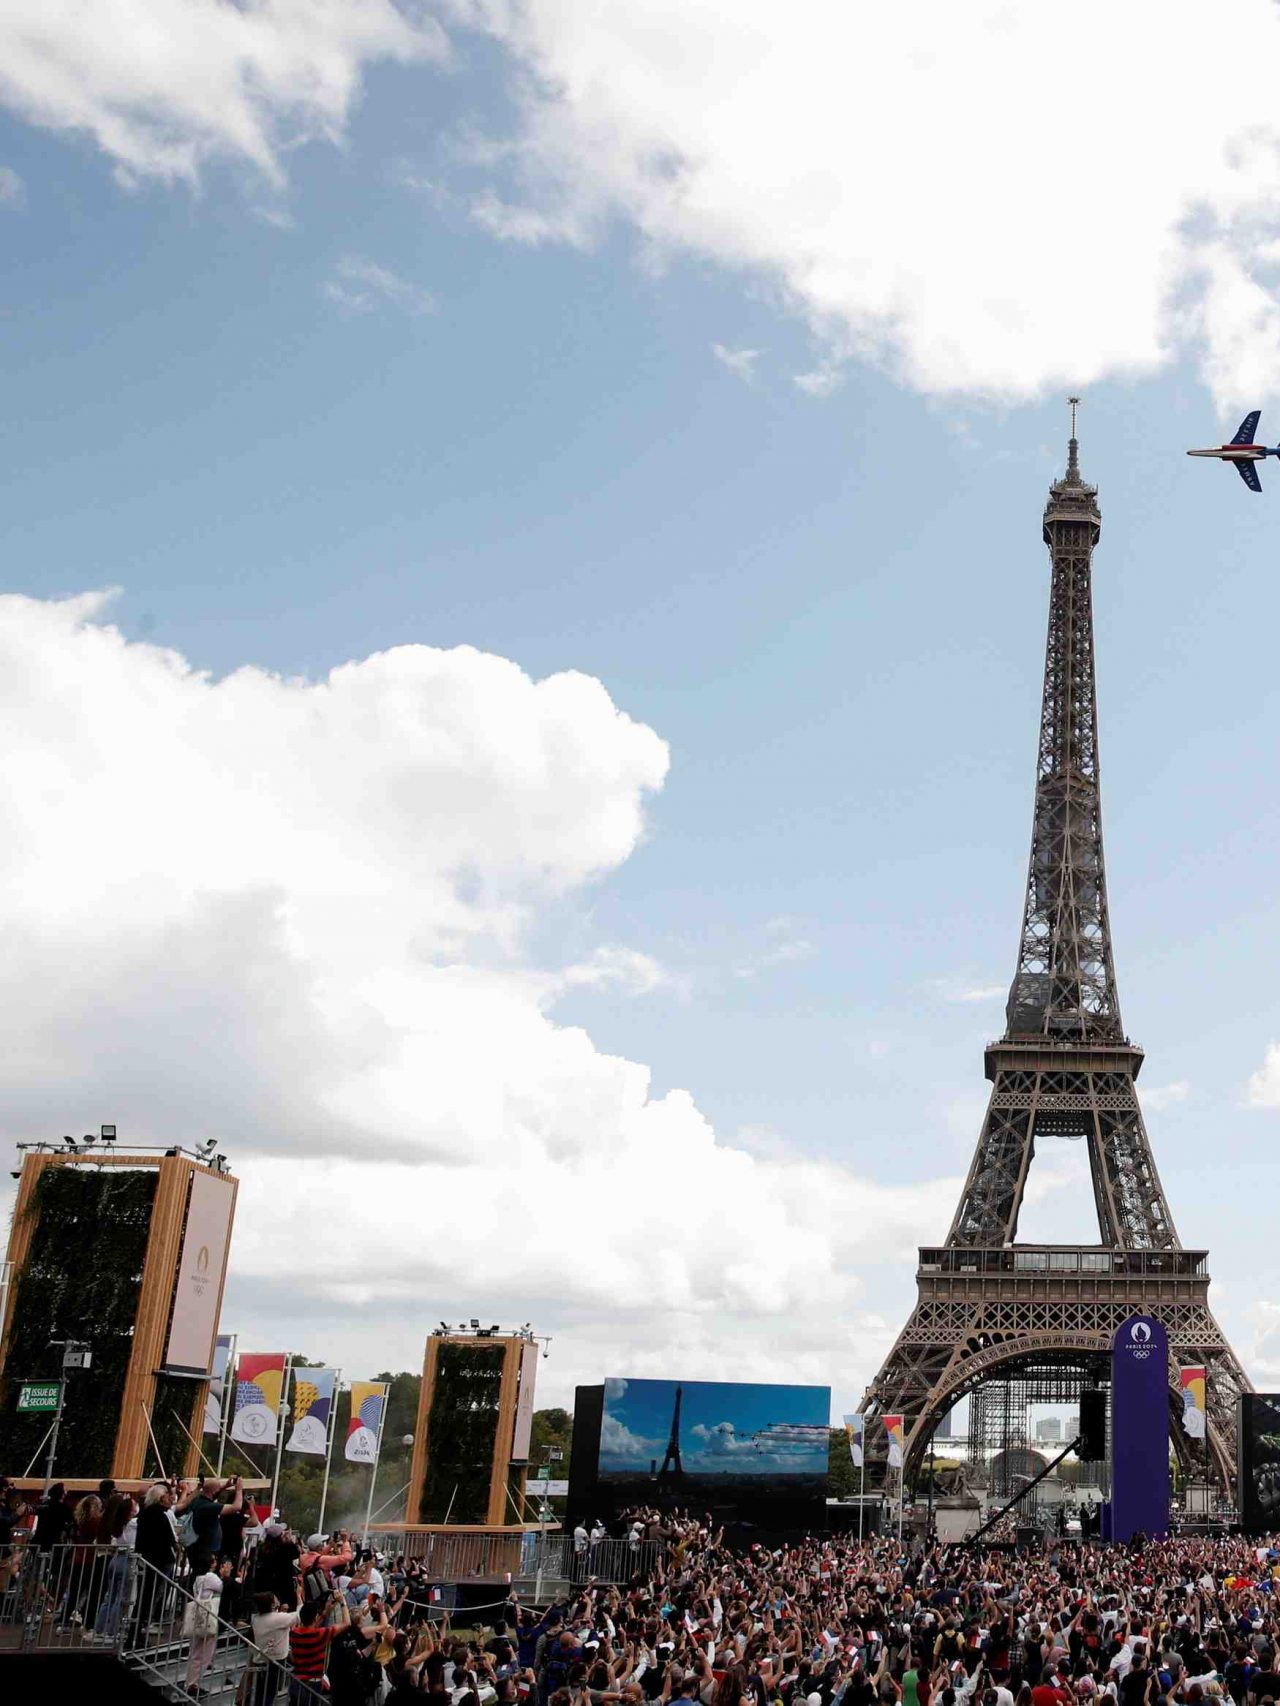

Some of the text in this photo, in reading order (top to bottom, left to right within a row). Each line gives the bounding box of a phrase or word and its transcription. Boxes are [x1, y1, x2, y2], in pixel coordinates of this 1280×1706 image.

[31, 1388, 58, 1396] ISSUE DE
[29, 1398, 57, 1406] SECOURS
